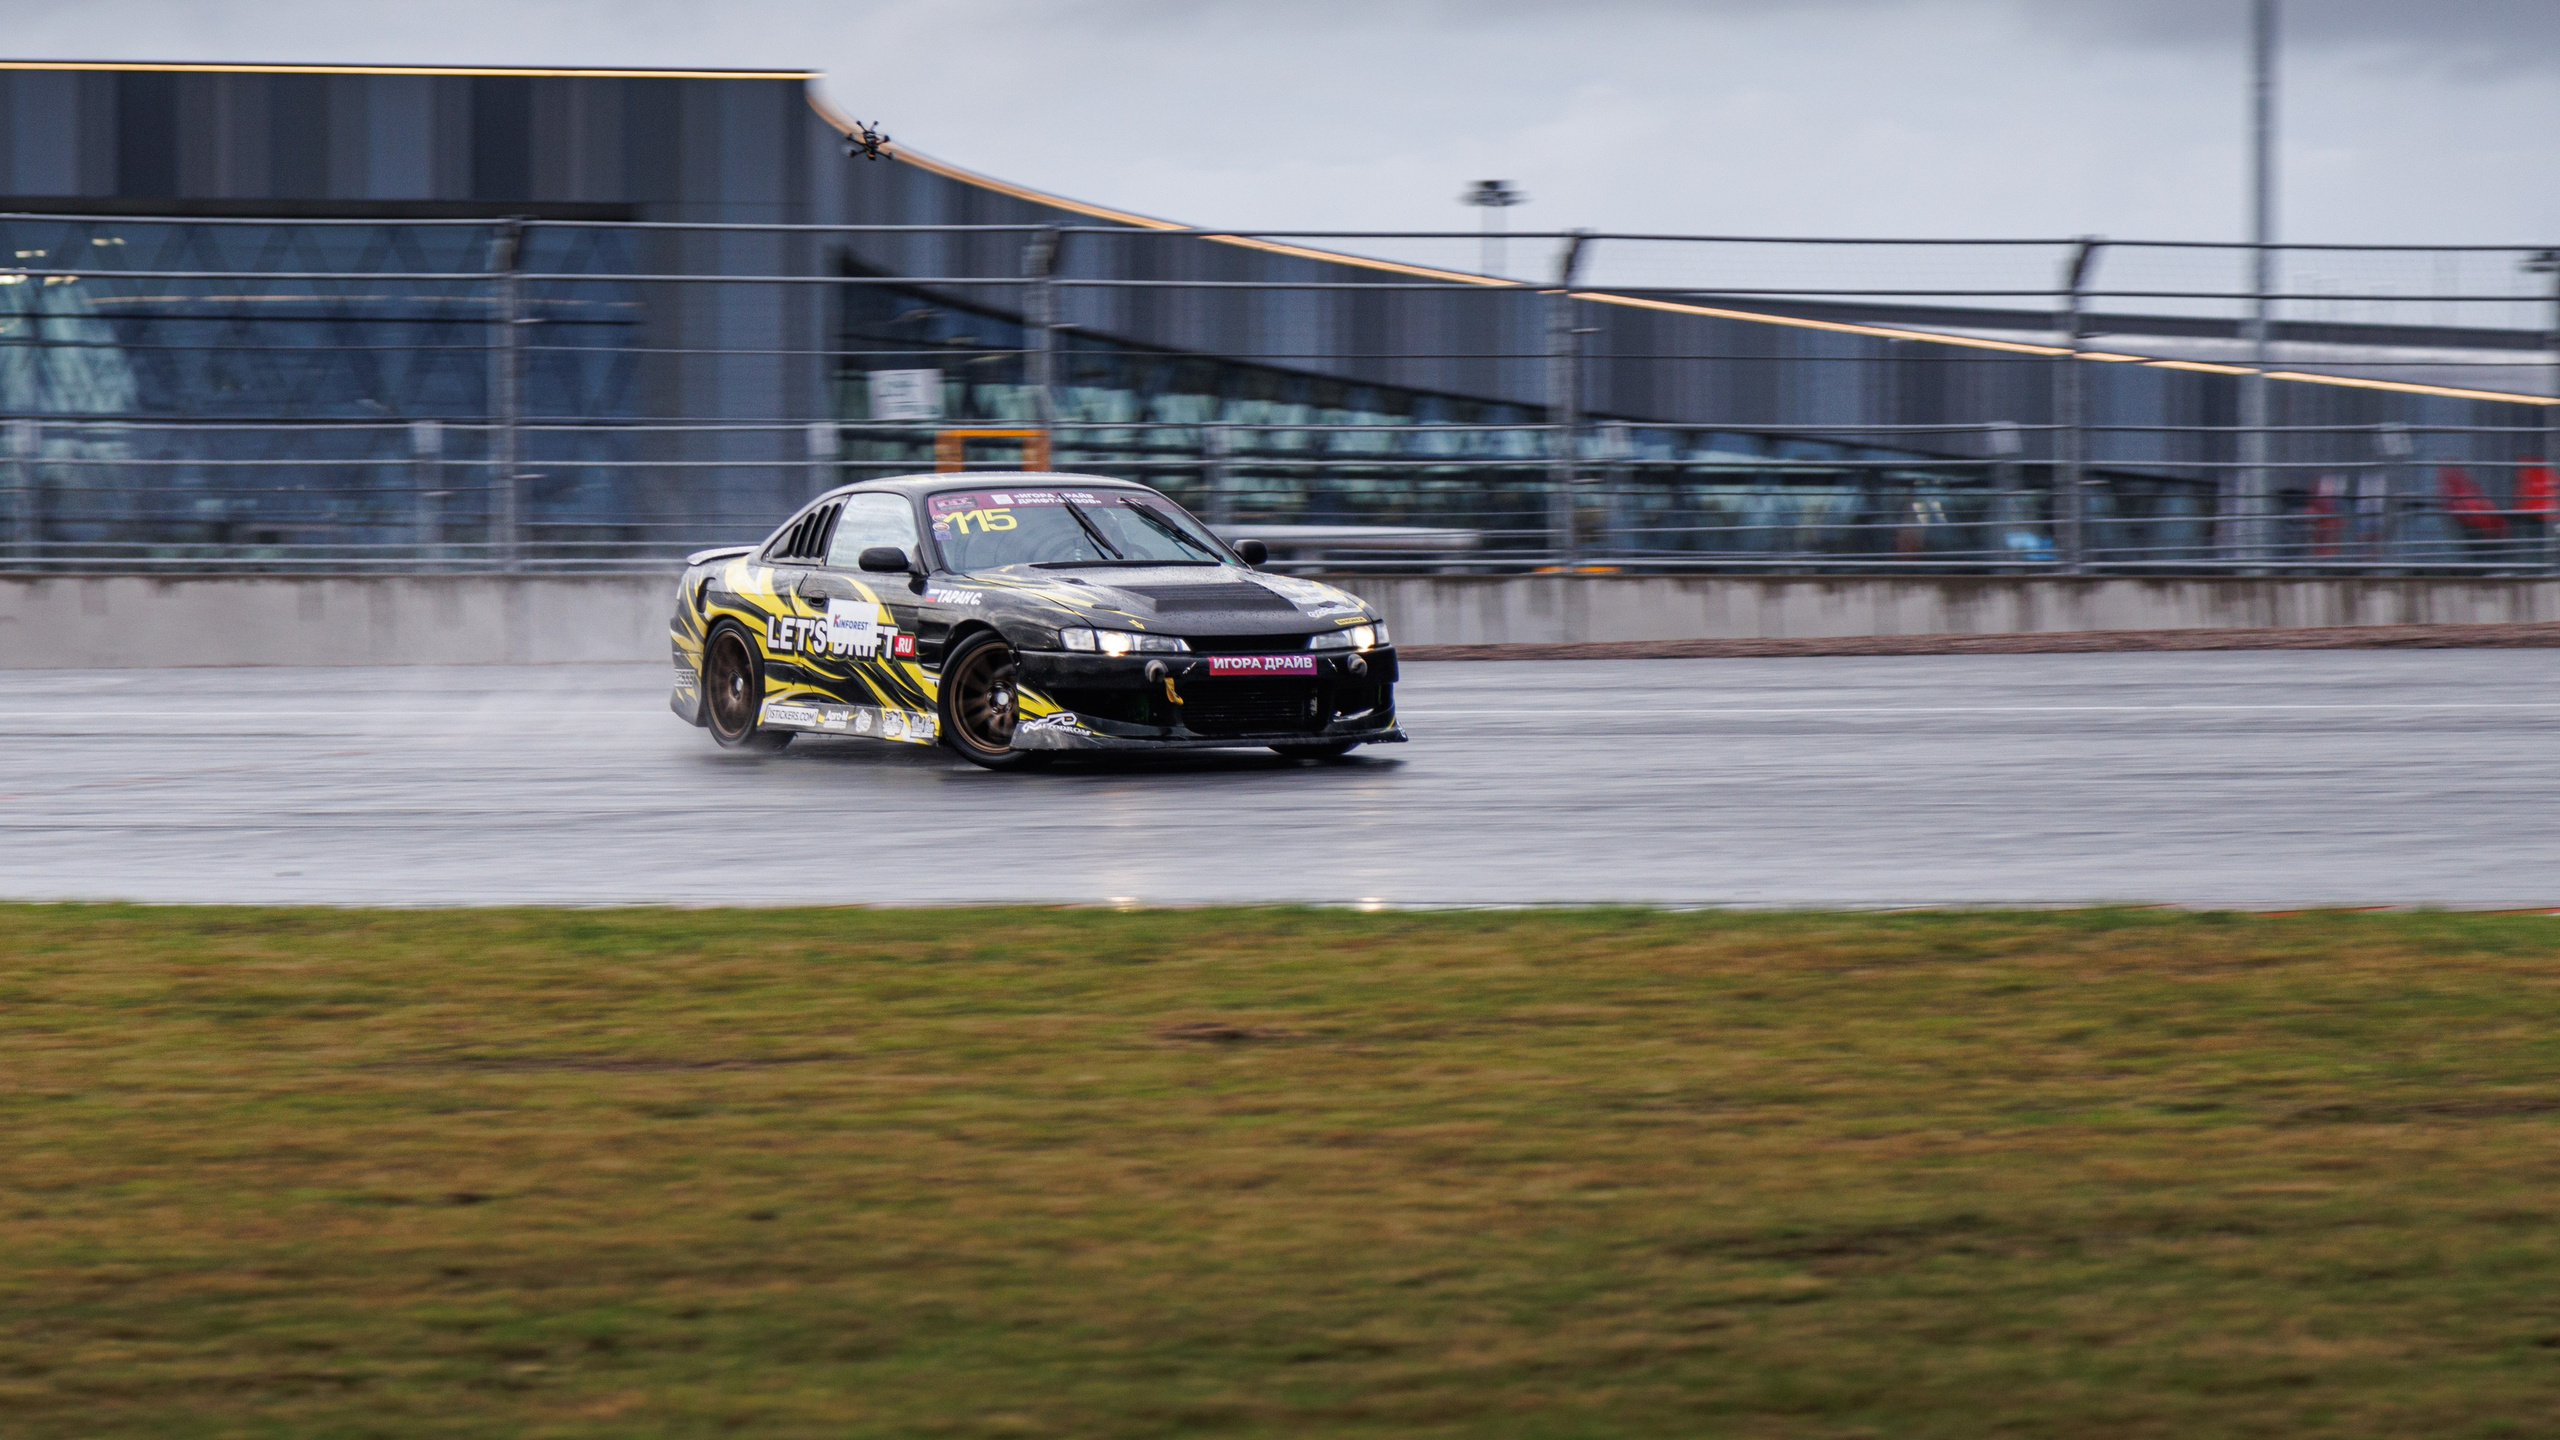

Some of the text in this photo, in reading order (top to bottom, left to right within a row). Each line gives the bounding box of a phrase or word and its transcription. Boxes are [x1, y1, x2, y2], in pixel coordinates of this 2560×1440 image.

[943, 508, 1018, 535] 115
[937, 589, 974, 604] ТАРАН
[767, 616, 827, 654] LET'S
[1213, 656, 1313, 670] ИГОРА ДРАЙВ
